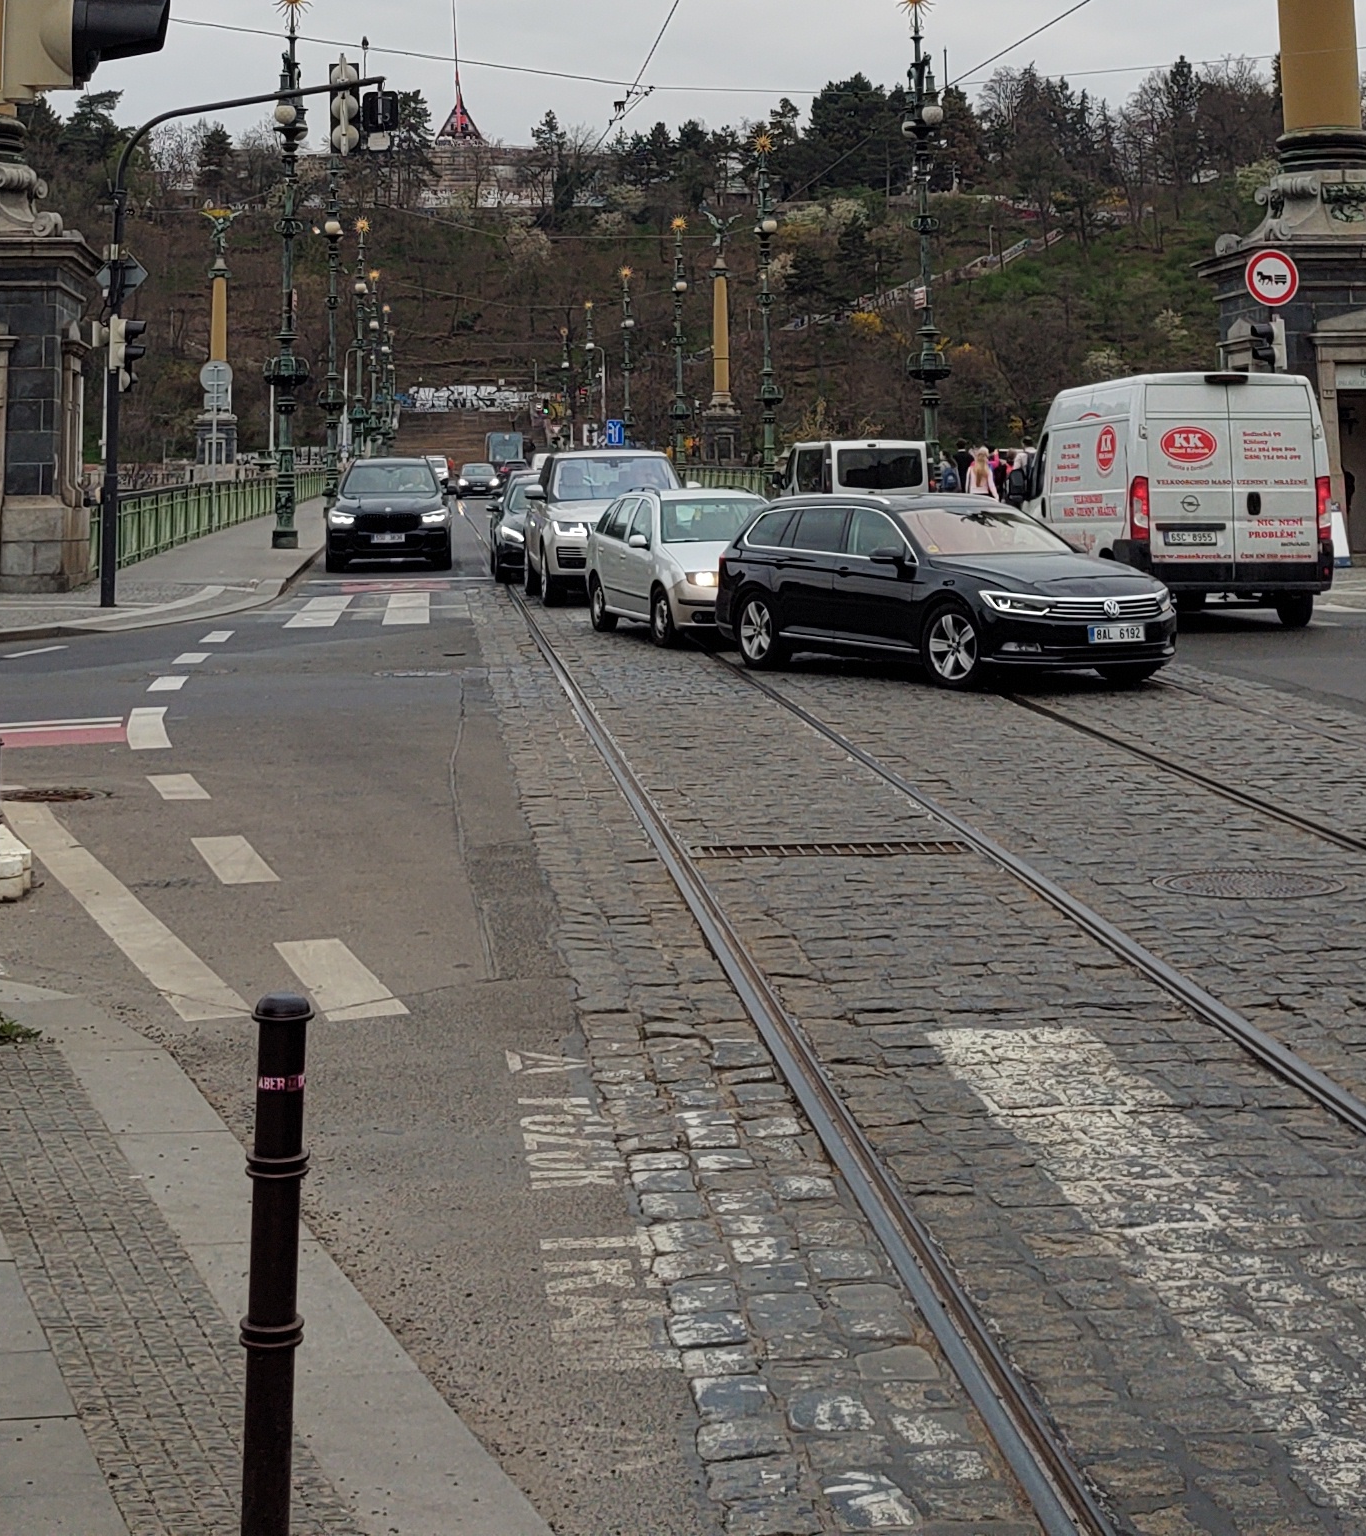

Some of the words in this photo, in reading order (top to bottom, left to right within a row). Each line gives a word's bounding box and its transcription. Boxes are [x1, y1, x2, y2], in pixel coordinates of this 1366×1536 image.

[1173, 433, 1204, 448] KK
[1279, 517, 1302, 526] NENÍ
[1171, 532, 1186, 542] 6SC
[1192, 532, 1213, 542] 8955
[1248, 529, 1296, 538] PROBLÉM!
[1096, 628, 1113, 640] 8AL
[1119, 627, 1141, 639] 6192
